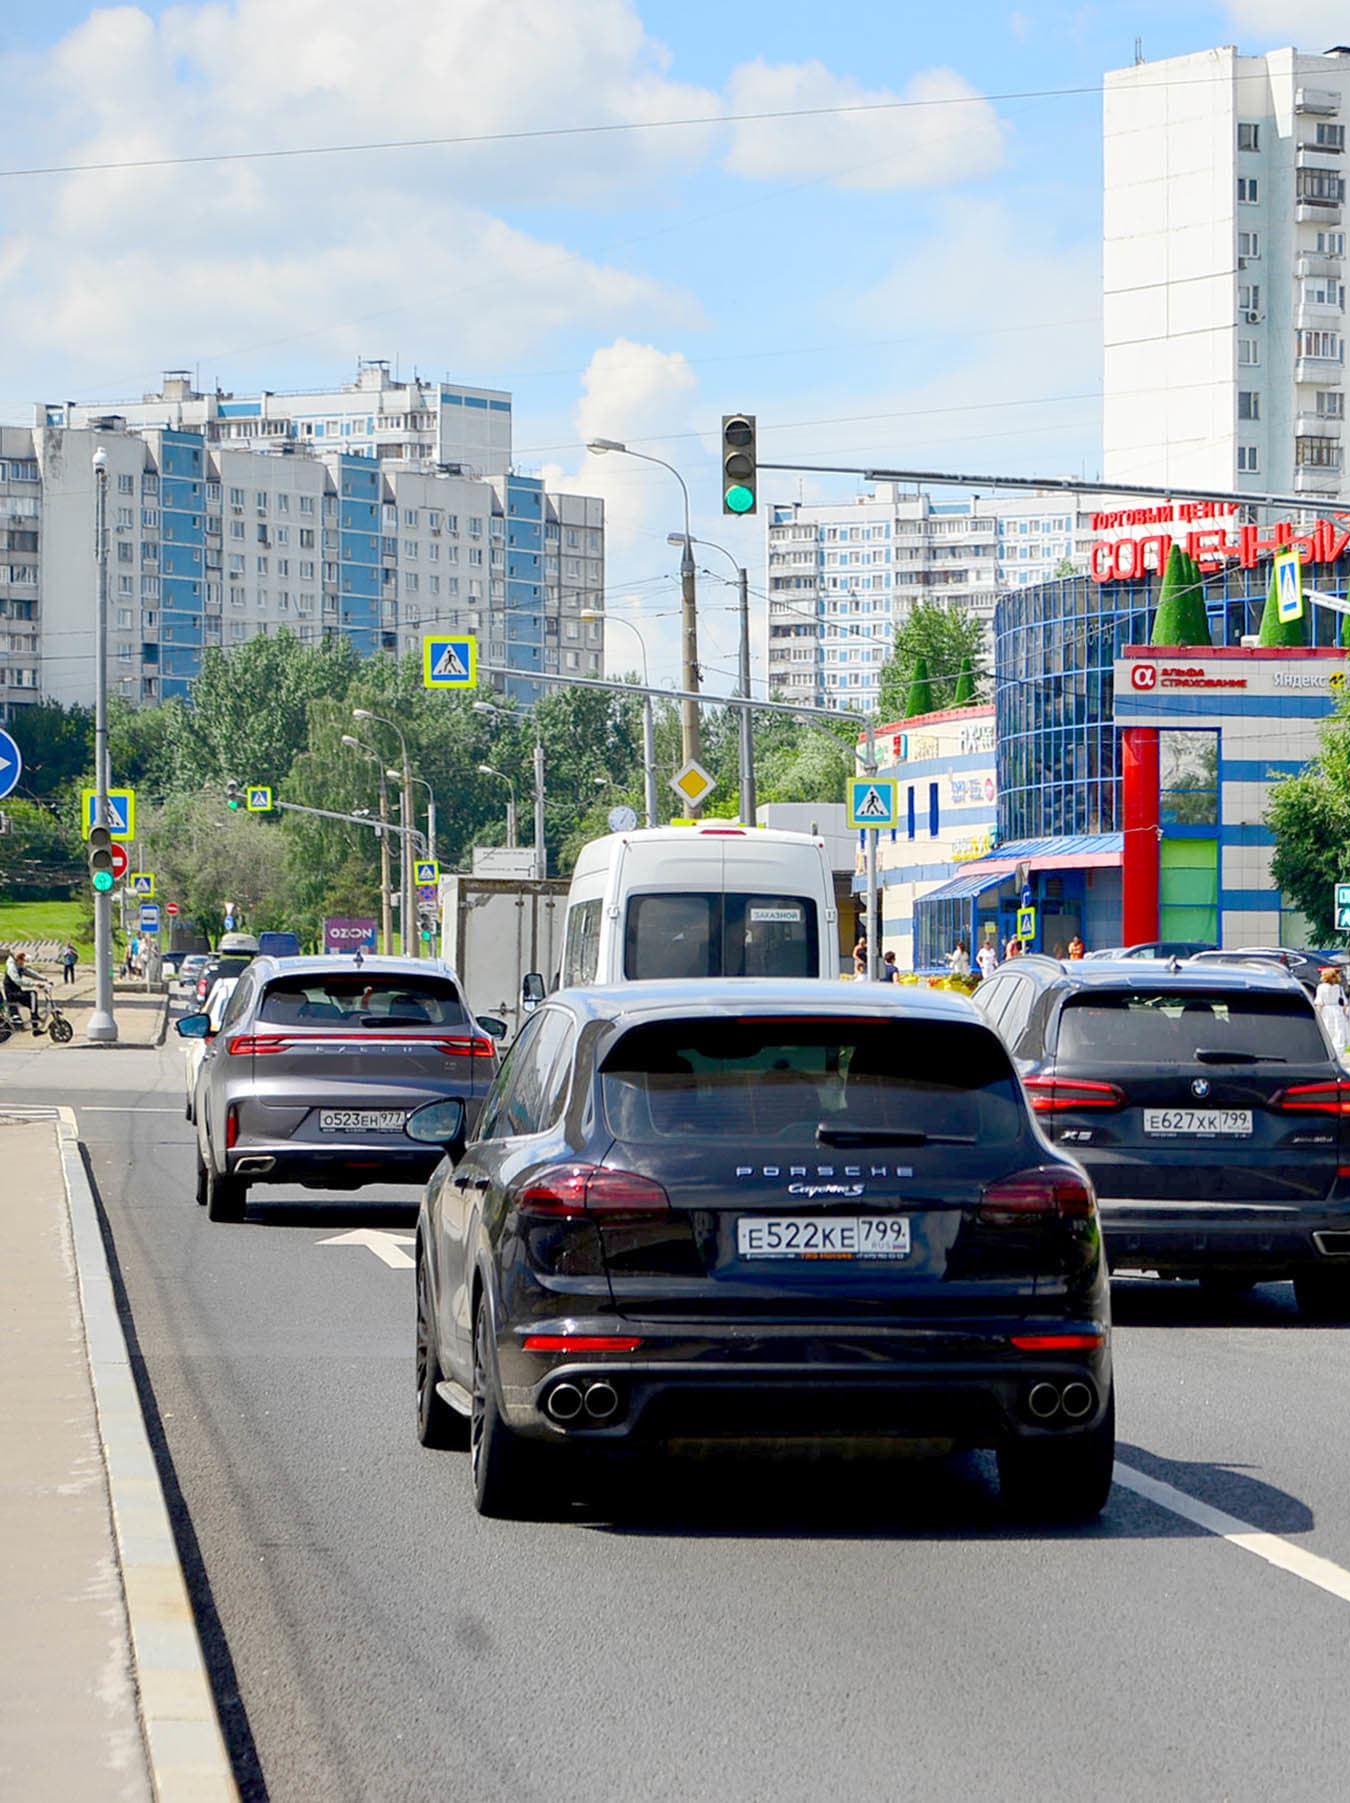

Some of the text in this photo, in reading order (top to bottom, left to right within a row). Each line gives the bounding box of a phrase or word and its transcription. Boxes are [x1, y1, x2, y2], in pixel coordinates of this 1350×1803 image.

[1088, 498, 1241, 531] ТОРГОВЫЙ ЦЕНТР
[1160, 668, 1205, 677] АЛЬФА
[1160, 679, 1248, 688] СТРАХОВАНИЕ
[1272, 672, 1328, 688] Яндекс
[330, 928, 373, 938] OZON
[736, 1166, 914, 1177] PORSCHE
[788, 1183, 849, 1198] Cayenne
